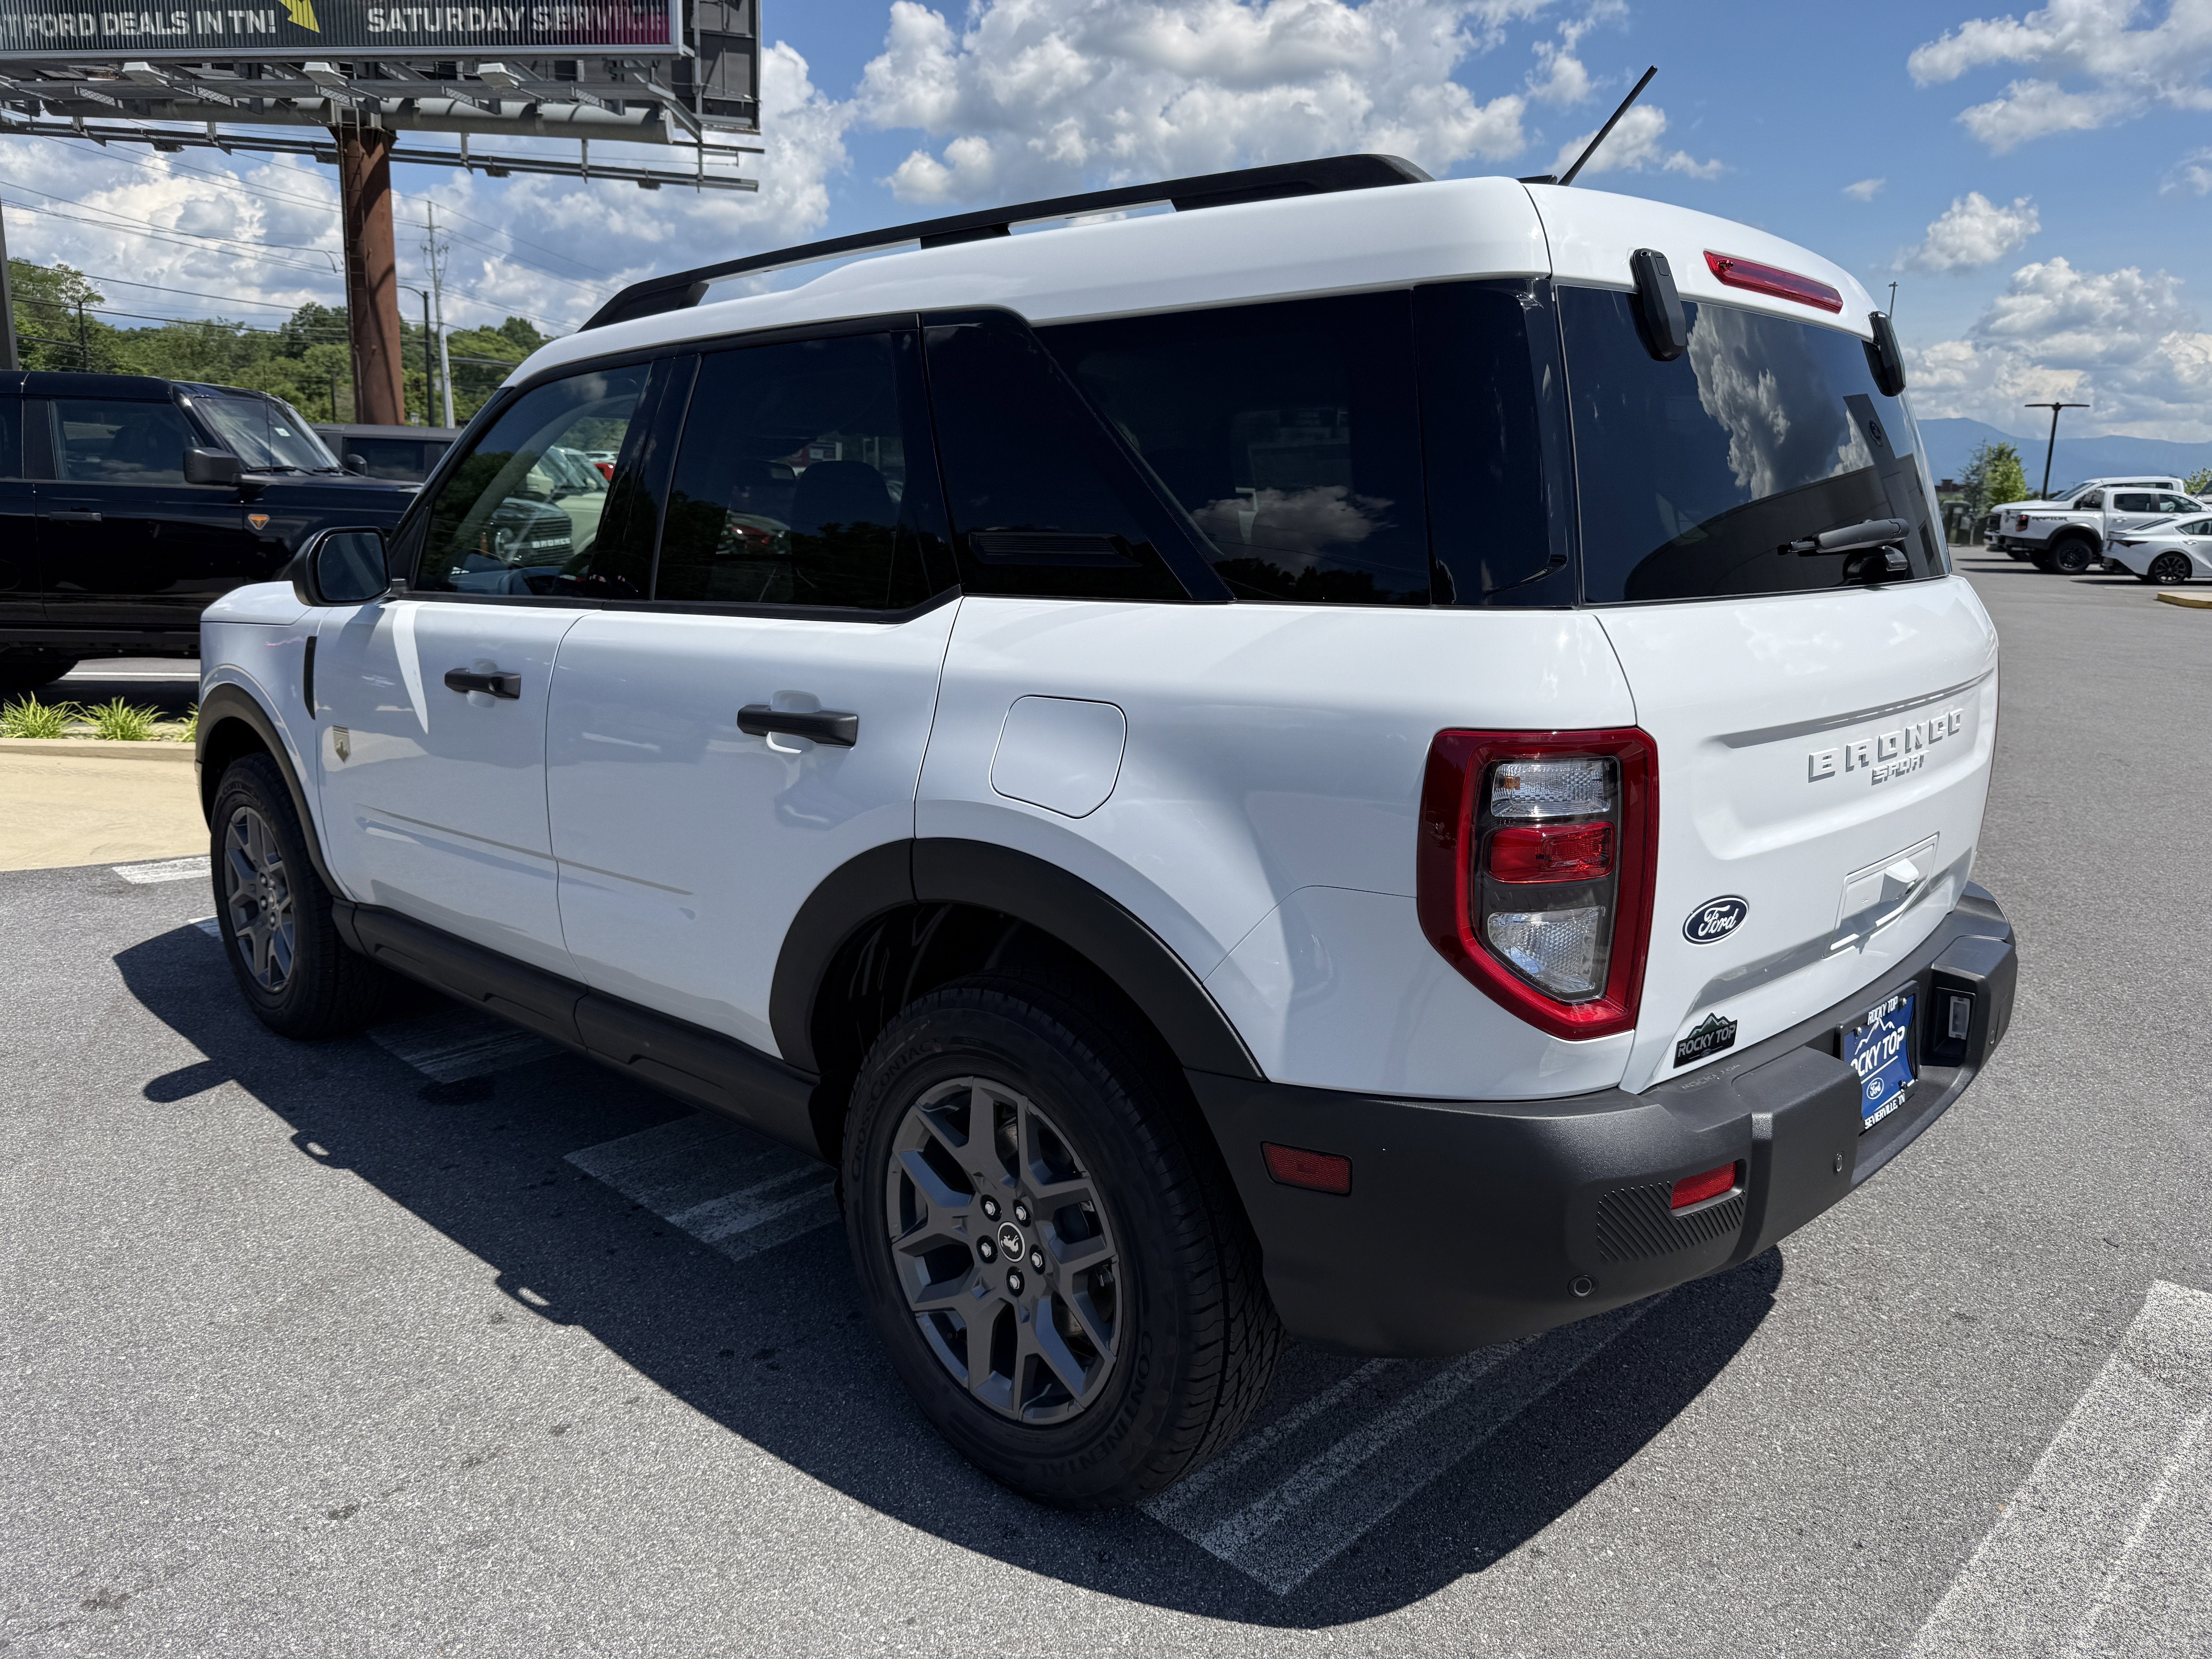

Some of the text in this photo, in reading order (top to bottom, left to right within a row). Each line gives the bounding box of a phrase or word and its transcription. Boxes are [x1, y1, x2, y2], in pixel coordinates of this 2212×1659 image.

[24, 12, 96, 37] FORD
[103, 11, 189, 36] DEALS
[196, 10, 222, 34] IN
[228, 10, 276, 34] TN!
[368, 6, 525, 32] SATURDAY
[1808, 708, 1964, 780] BRONCO
[1872, 750, 1930, 783] SPORT
[1698, 905, 1739, 936] Ford
[1867, 996, 1898, 1025] ROCKY TOP
[1678, 1032, 1715, 1057] ROCKY
[1716, 1024, 1736, 1043] TOP
[1882, 1025, 1905, 1060] TOP
[1864, 1093, 1905, 1130] SEVIERVILLE, TN
